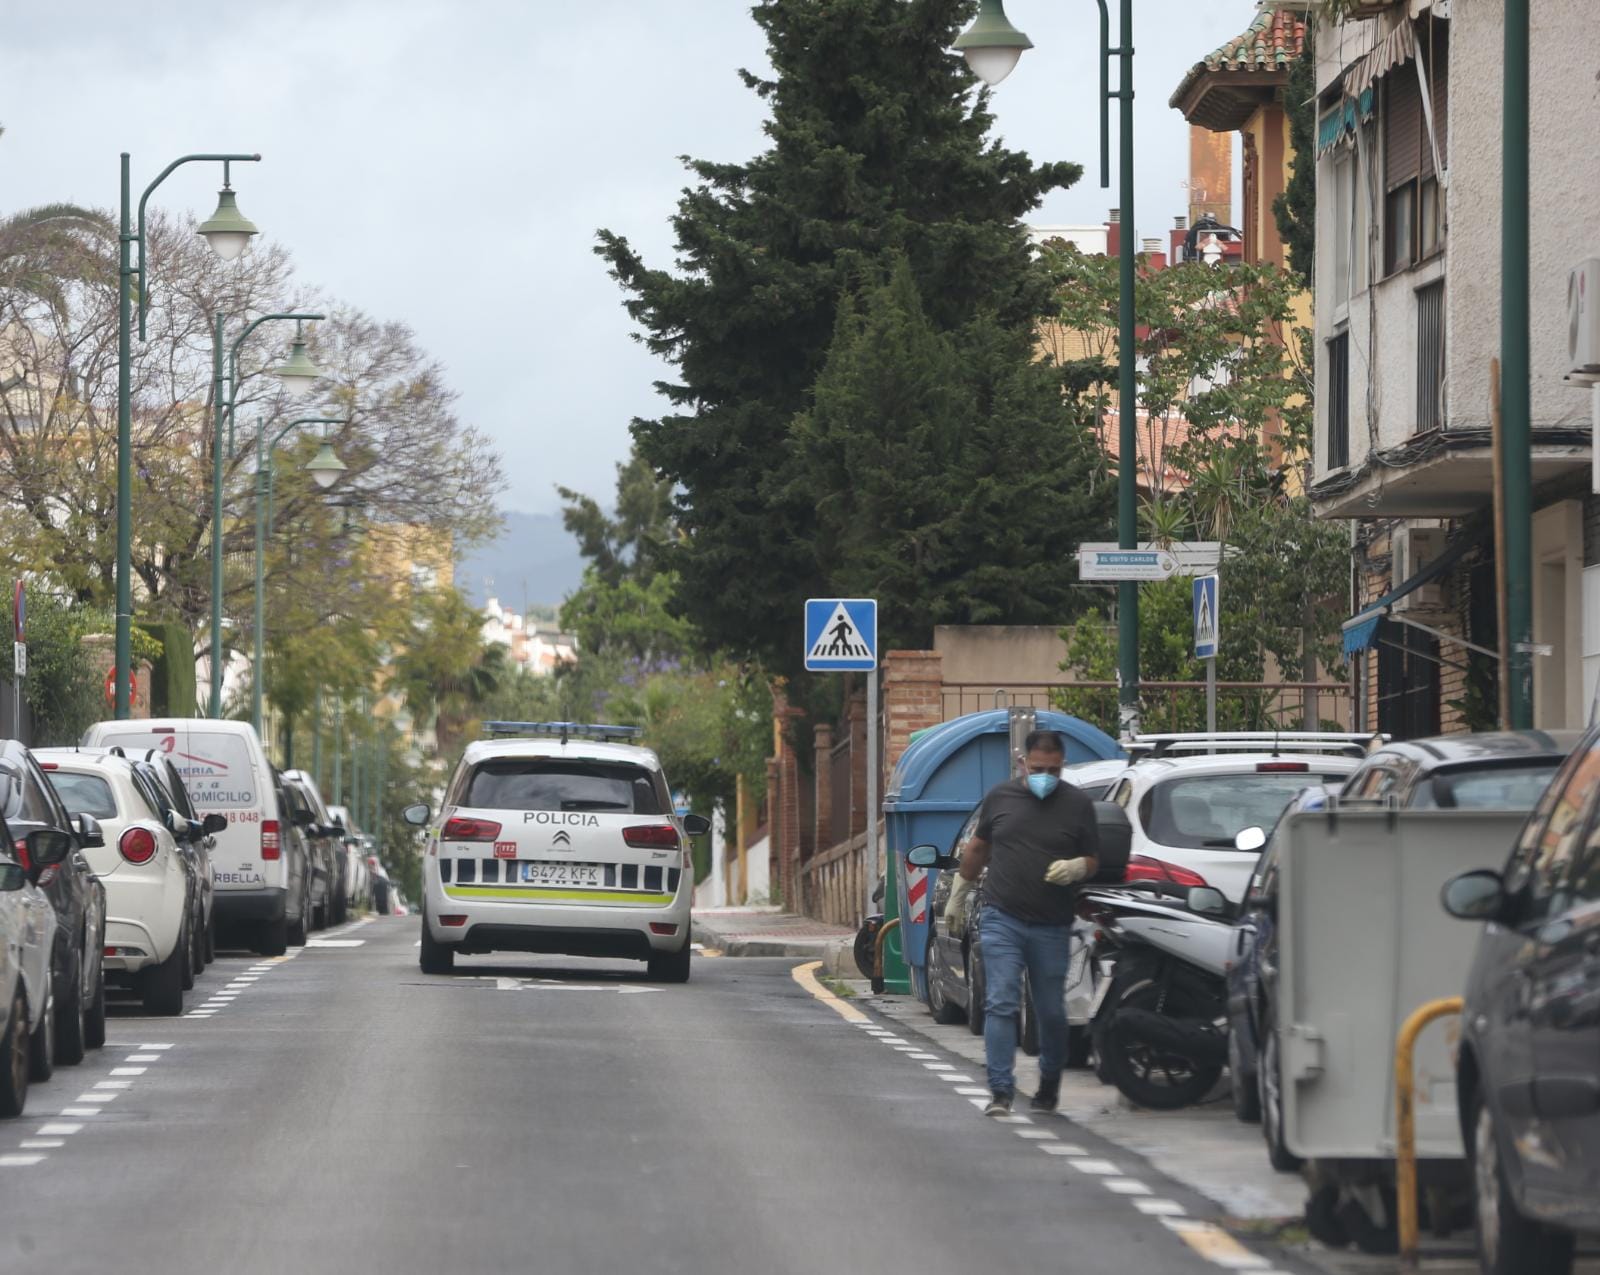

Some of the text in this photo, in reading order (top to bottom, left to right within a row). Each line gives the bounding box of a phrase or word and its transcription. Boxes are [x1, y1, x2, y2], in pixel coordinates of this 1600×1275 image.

[190, 791, 252, 803] OMICILIO
[523, 811, 600, 827] POLICIA
[214, 873, 260, 883] RBELLA
[531, 866, 597, 880] 6472 KFK
